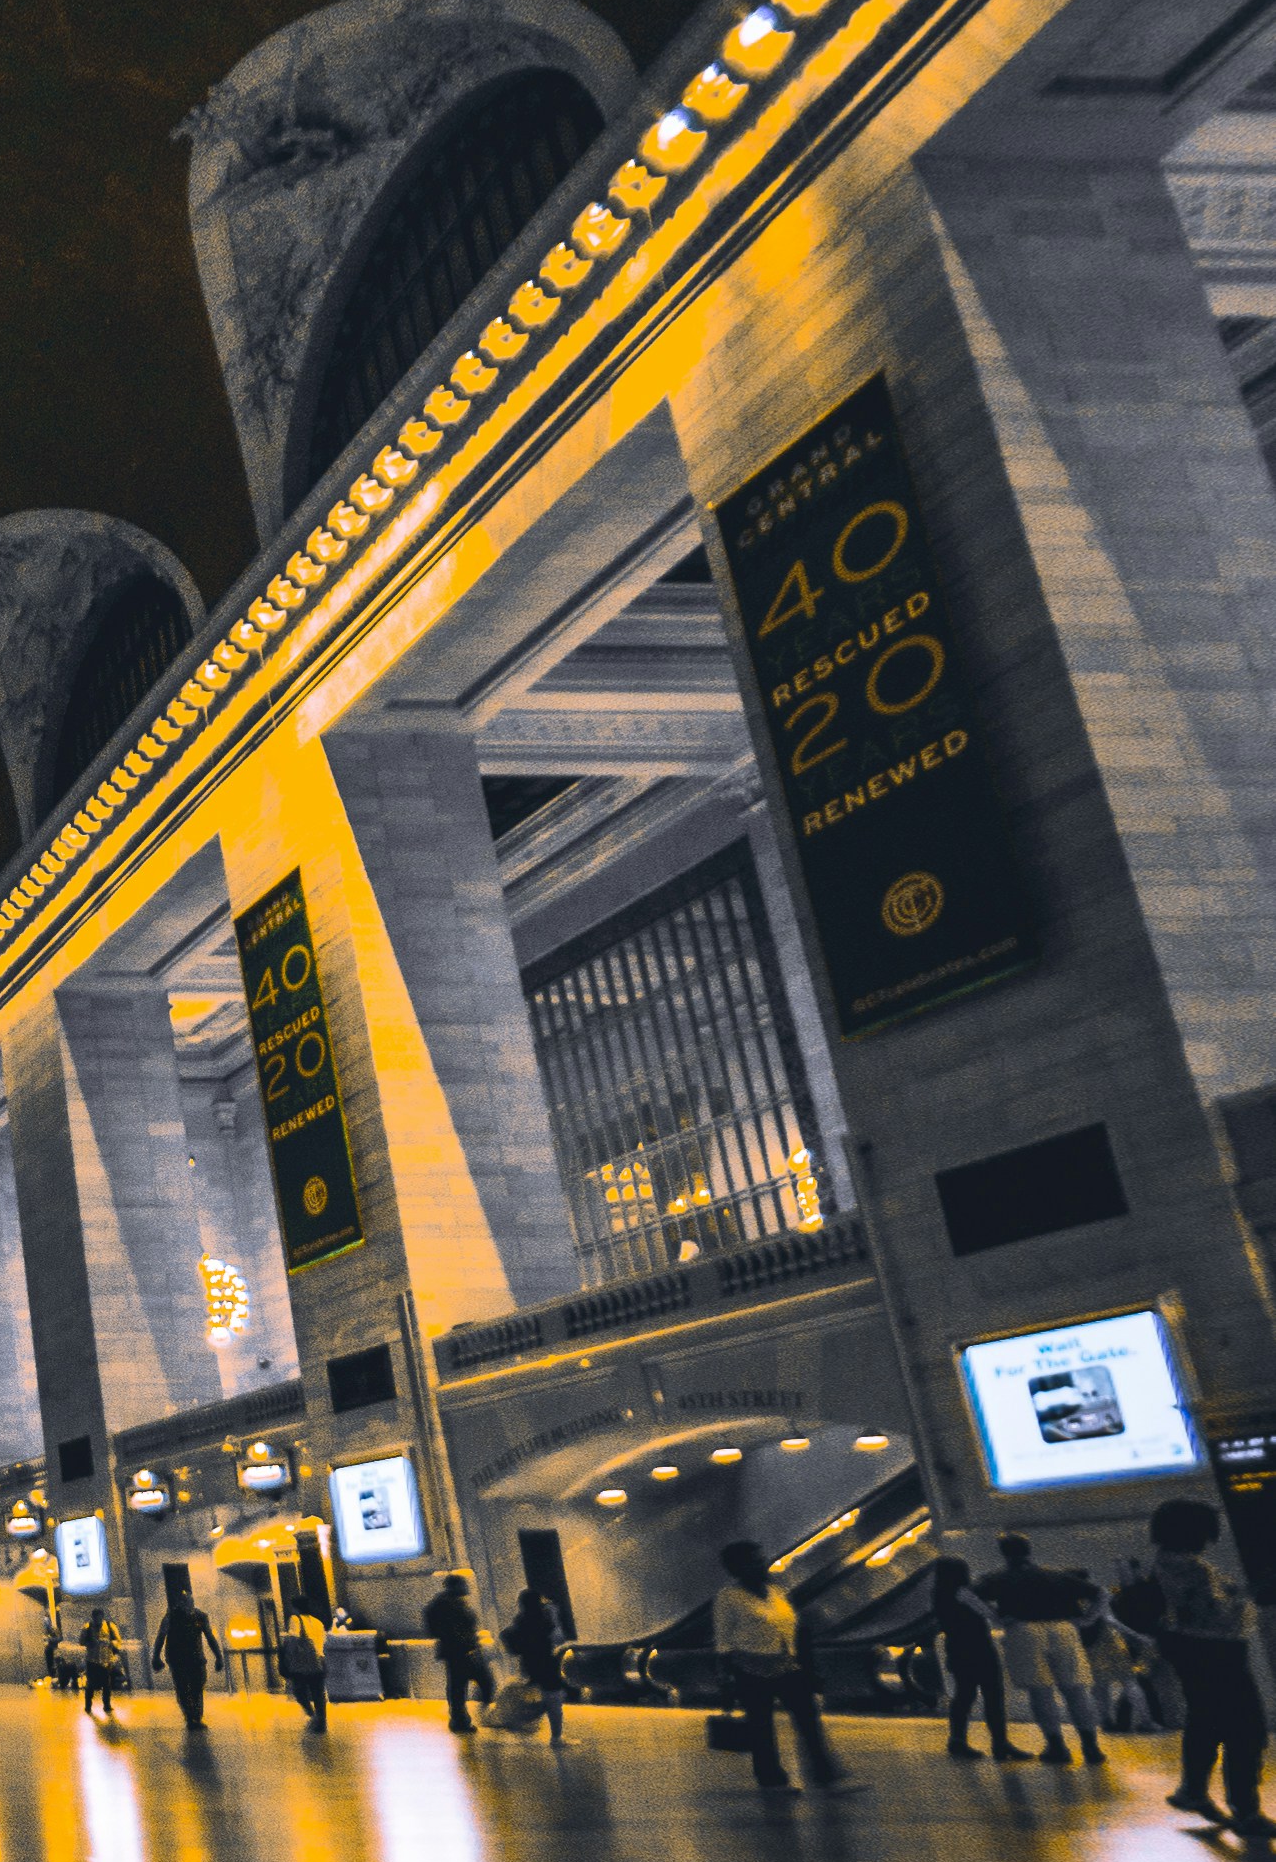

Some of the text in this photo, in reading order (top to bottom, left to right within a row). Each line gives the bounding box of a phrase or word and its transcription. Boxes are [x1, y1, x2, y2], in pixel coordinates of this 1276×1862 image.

[737, 431, 882, 549] CENTRAL
[757, 500, 909, 640] 40
[771, 591, 930, 708] RESCUED
[783, 633, 946, 776] 20
[802, 729, 969, 837] RENEWED
[251, 943, 312, 1011] 40
[258, 1004, 322, 1056] RESCUED
[264, 1030, 327, 1103] 20
[271, 1093, 336, 1140] RENEWED
[994, 1364, 1027, 1379] For
[1033, 1357, 1071, 1371] The
[1036, 1336, 1082, 1354] Wait
[728, 1388, 806, 1408] STREET
